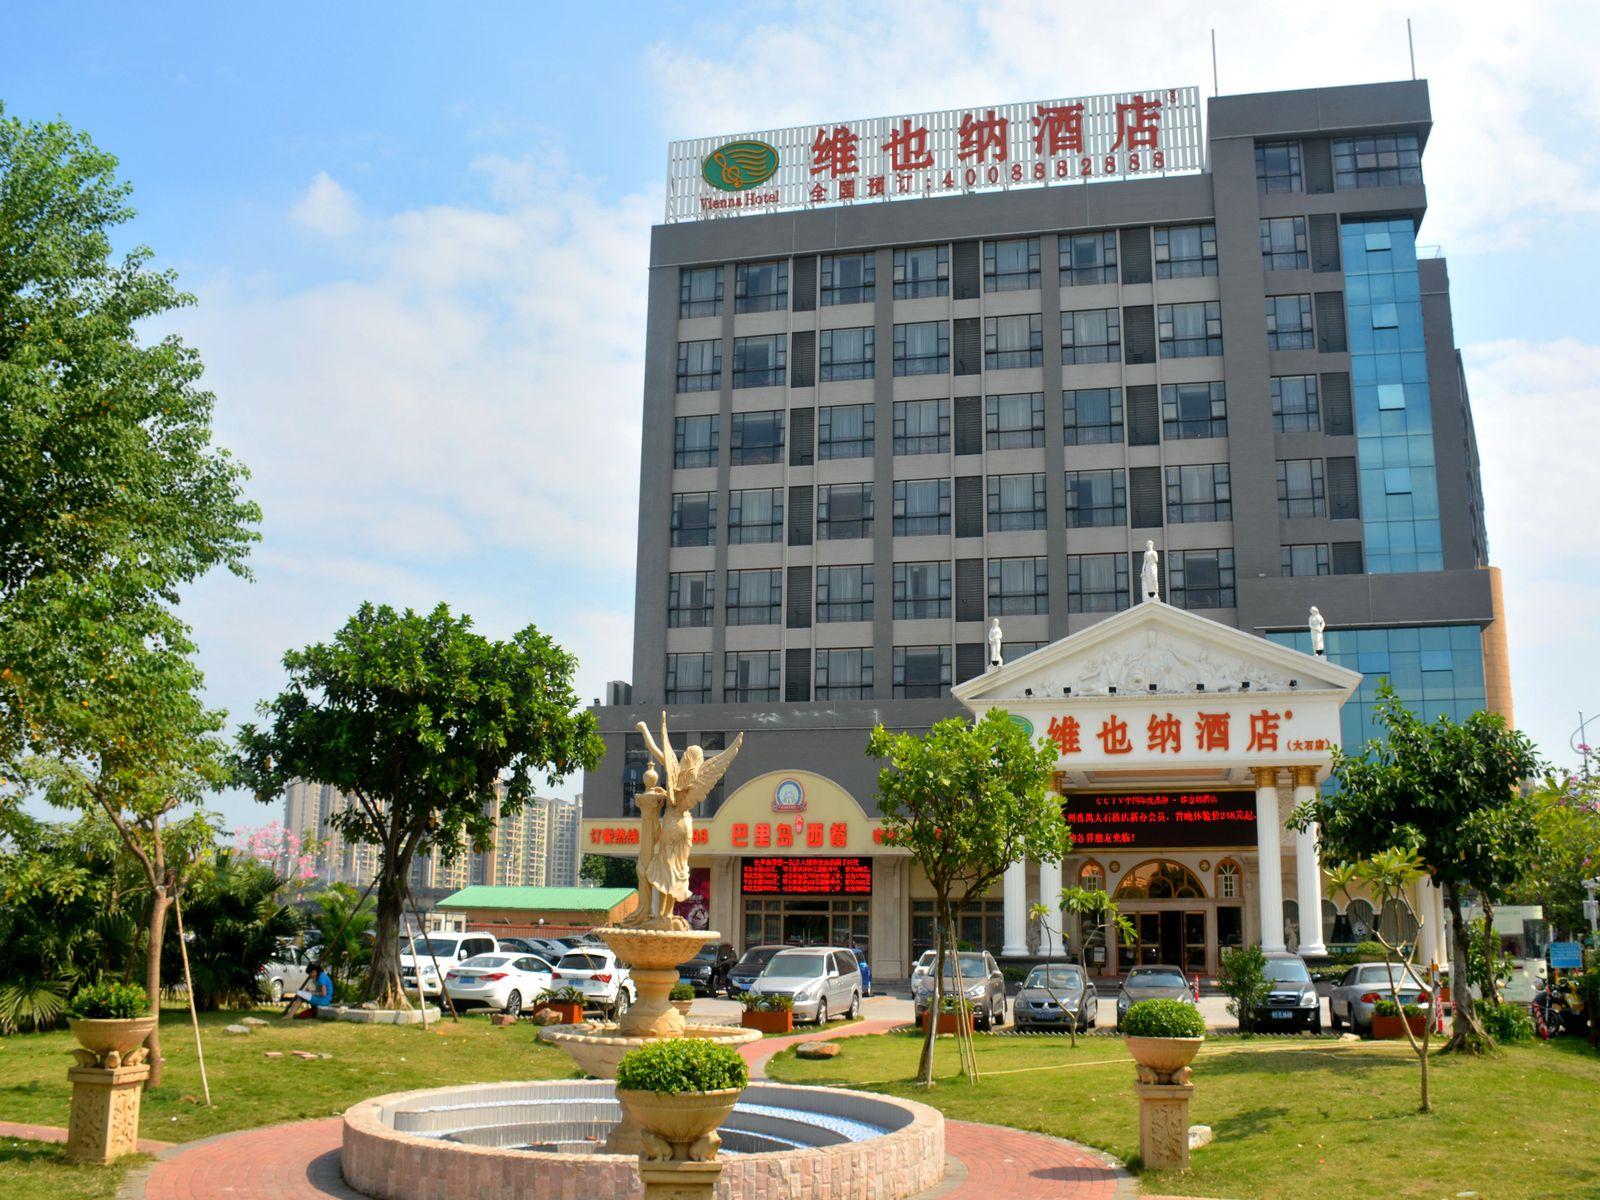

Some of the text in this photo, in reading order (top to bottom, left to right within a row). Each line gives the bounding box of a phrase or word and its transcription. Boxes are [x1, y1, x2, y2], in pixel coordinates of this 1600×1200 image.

[810, 95, 1162, 179] 维也纳酒店
[700, 190, 779, 210] Vienna Hotel
[1047, 710, 1280, 755] 维也纳酒店
[731, 823, 847, 847] 巴里岛西餐
